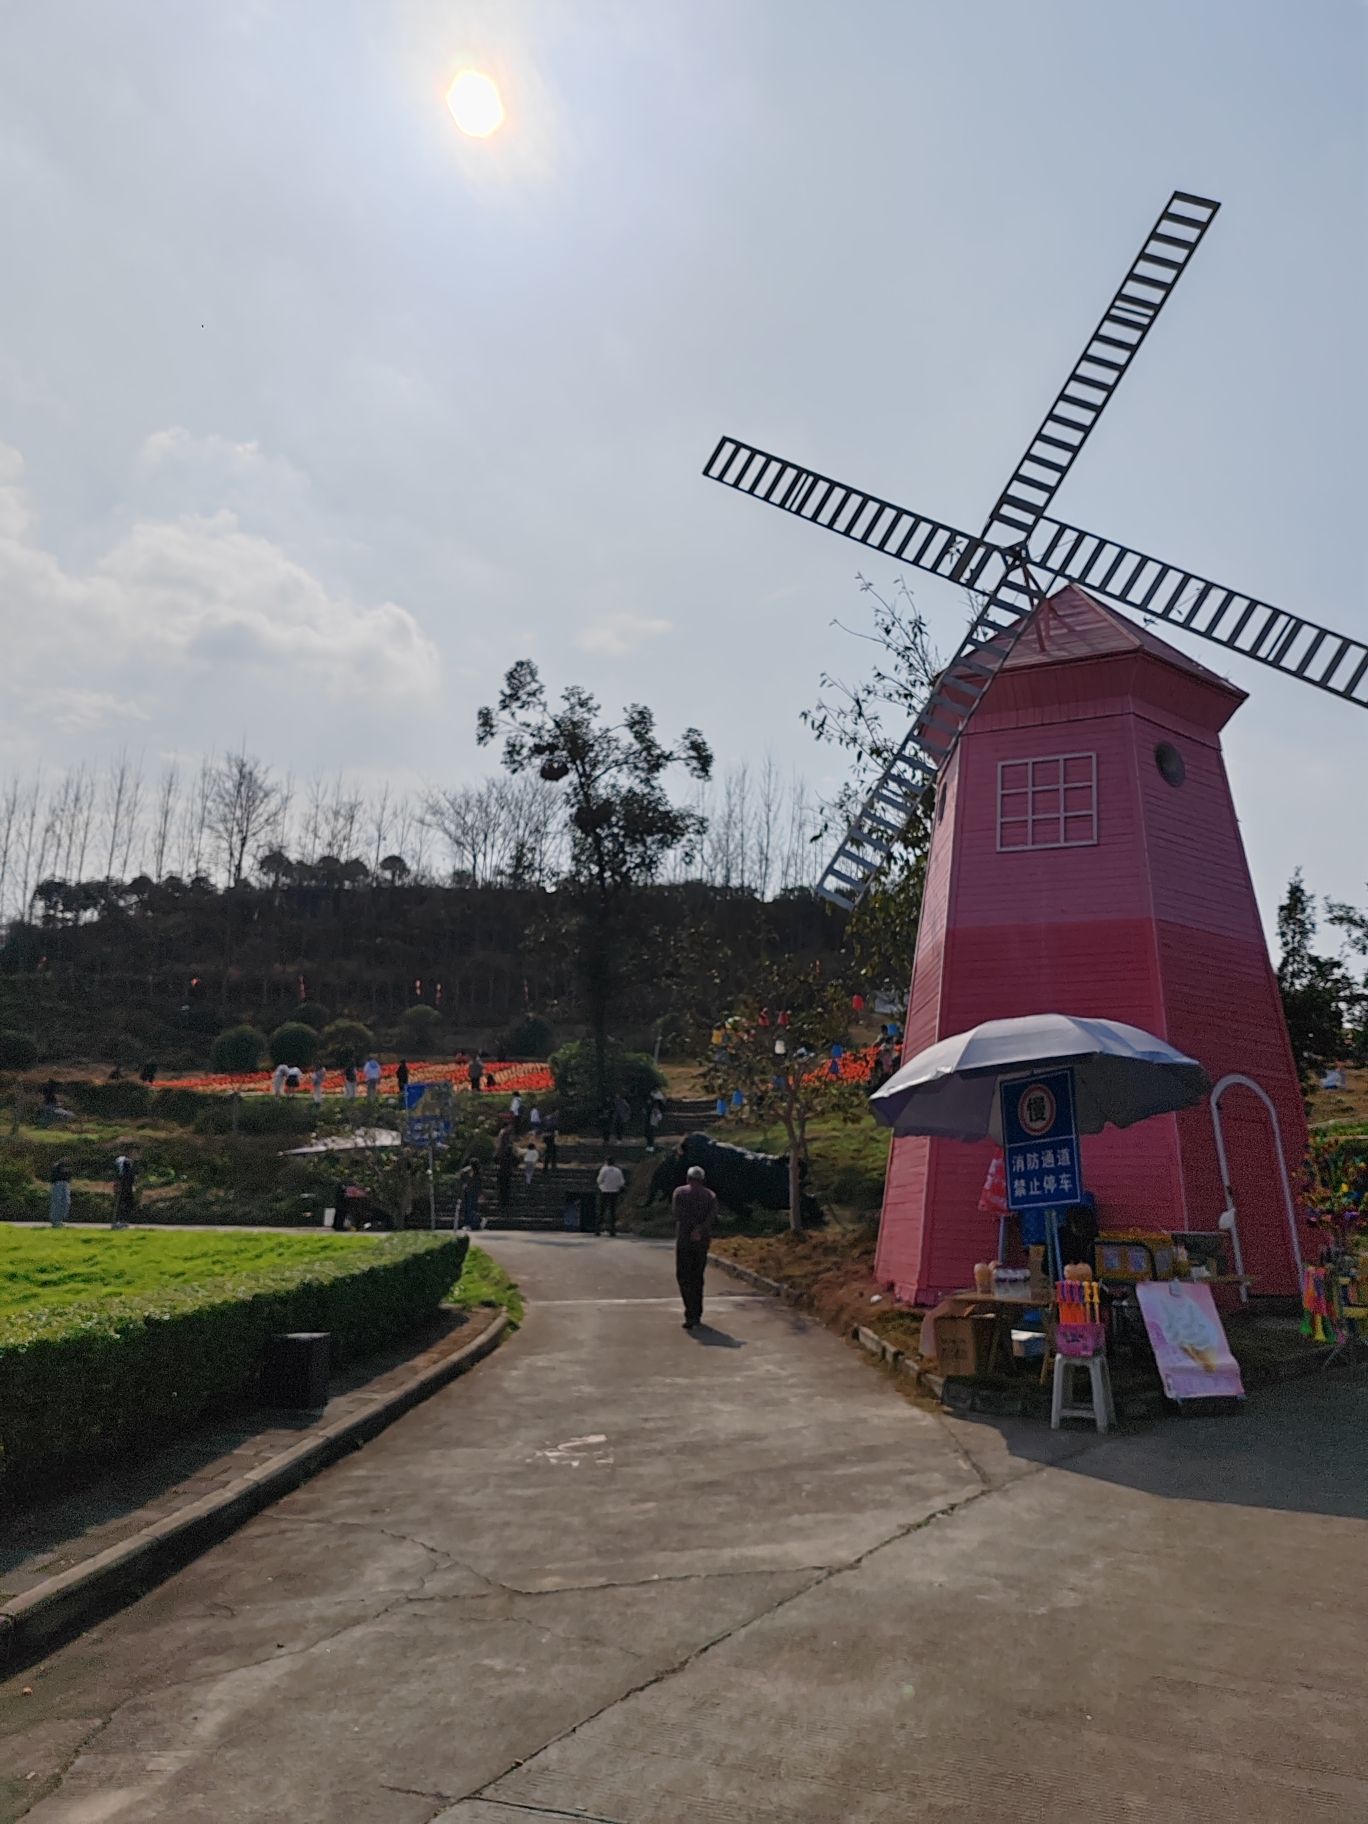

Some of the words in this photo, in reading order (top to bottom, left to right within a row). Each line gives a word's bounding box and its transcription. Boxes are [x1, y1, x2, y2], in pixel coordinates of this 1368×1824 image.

[1012, 1148, 1071, 1173] 消防通道
[1014, 1173, 1073, 1198] 禁止停车
